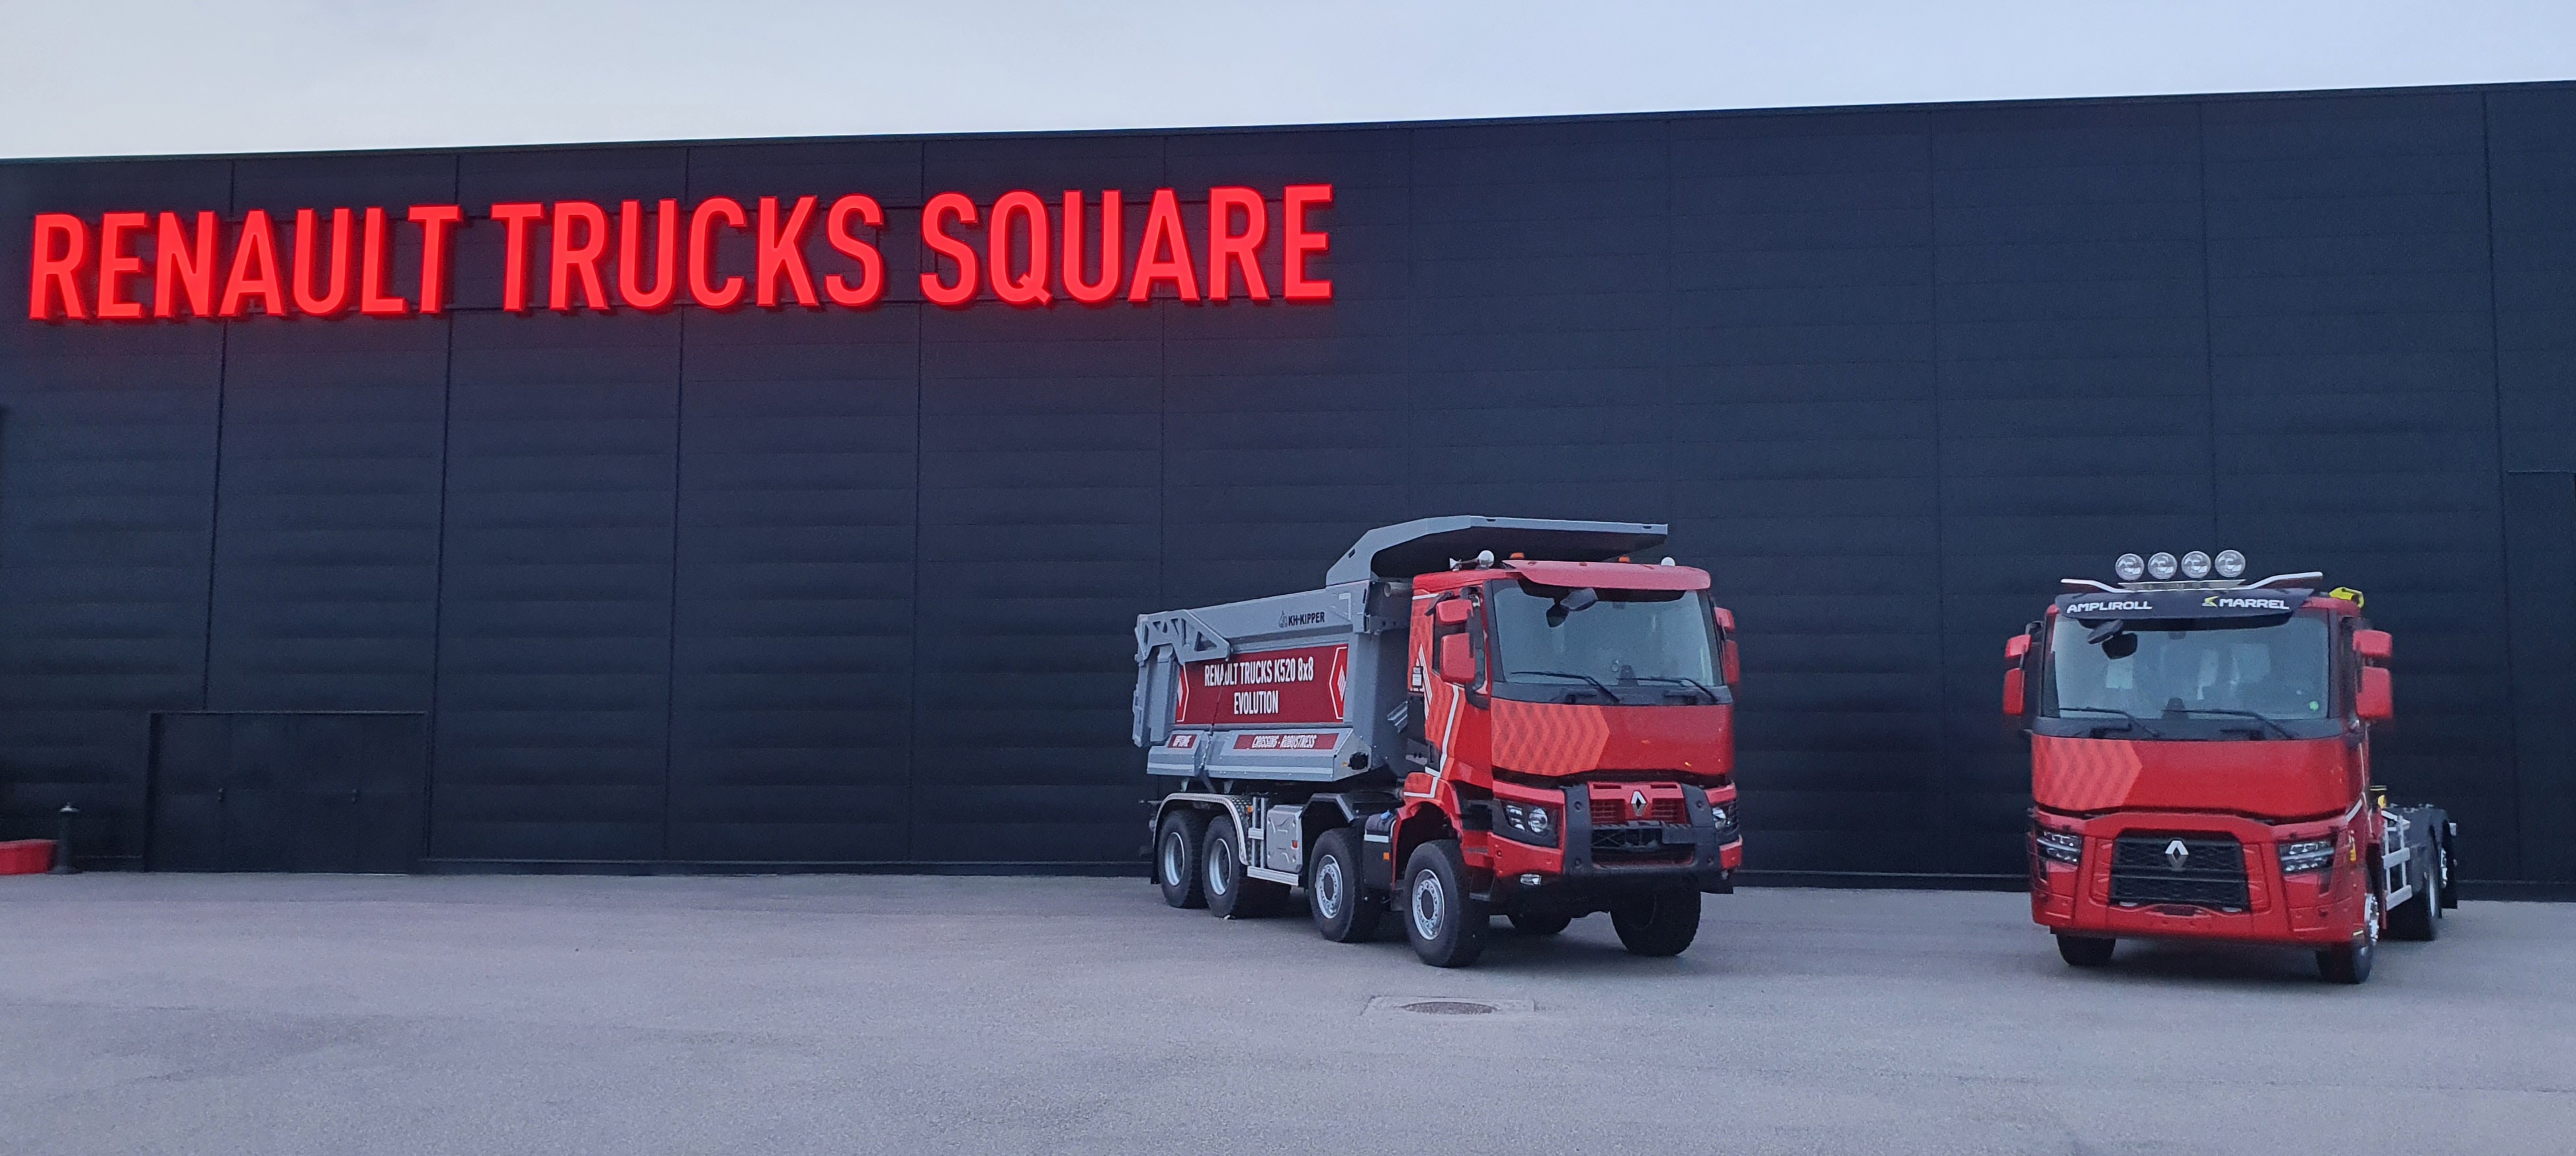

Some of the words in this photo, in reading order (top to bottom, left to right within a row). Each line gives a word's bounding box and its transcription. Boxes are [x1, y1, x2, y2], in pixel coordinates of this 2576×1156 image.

[29, 203, 462, 320] RENAULT
[490, 193, 884, 312] TRUCKS
[918, 183, 1334, 308] SQUARE
[2066, 601, 2153, 613] AMPLIROLL
[2219, 598, 2289, 609] MARREL
[1288, 611, 1325, 627] KH-KIPPER
[1204, 662, 1239, 687] RENAULT
[1239, 660, 1272, 685] TRUCKS
[1274, 657, 1296, 683] K520
[1298, 656, 1314, 682] 8x8
[1233, 689, 1278, 715] EVOLUTION
